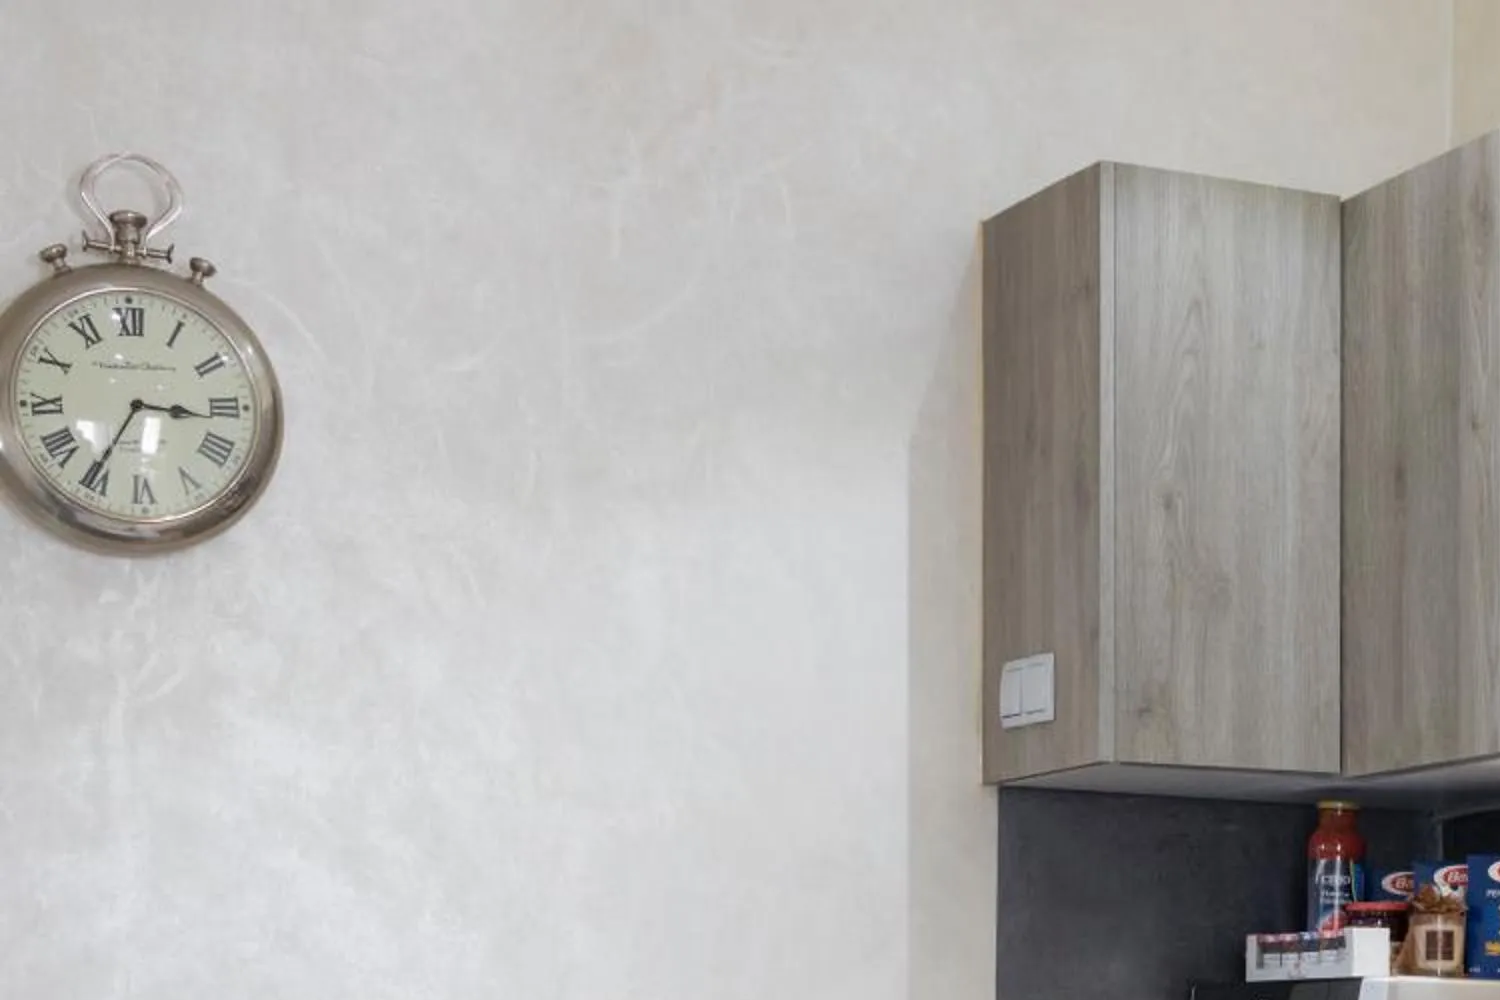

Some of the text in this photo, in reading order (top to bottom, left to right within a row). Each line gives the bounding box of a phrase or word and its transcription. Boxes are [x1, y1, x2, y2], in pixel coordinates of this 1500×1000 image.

[68, 313, 103, 349] XI
[113, 307, 145, 337] XII
[38, 348, 73, 375] X
[30, 392, 64, 416] IX
[208, 397, 240, 418] III
[132, 473, 157, 505] VI
[177, 466, 201, 495] V
